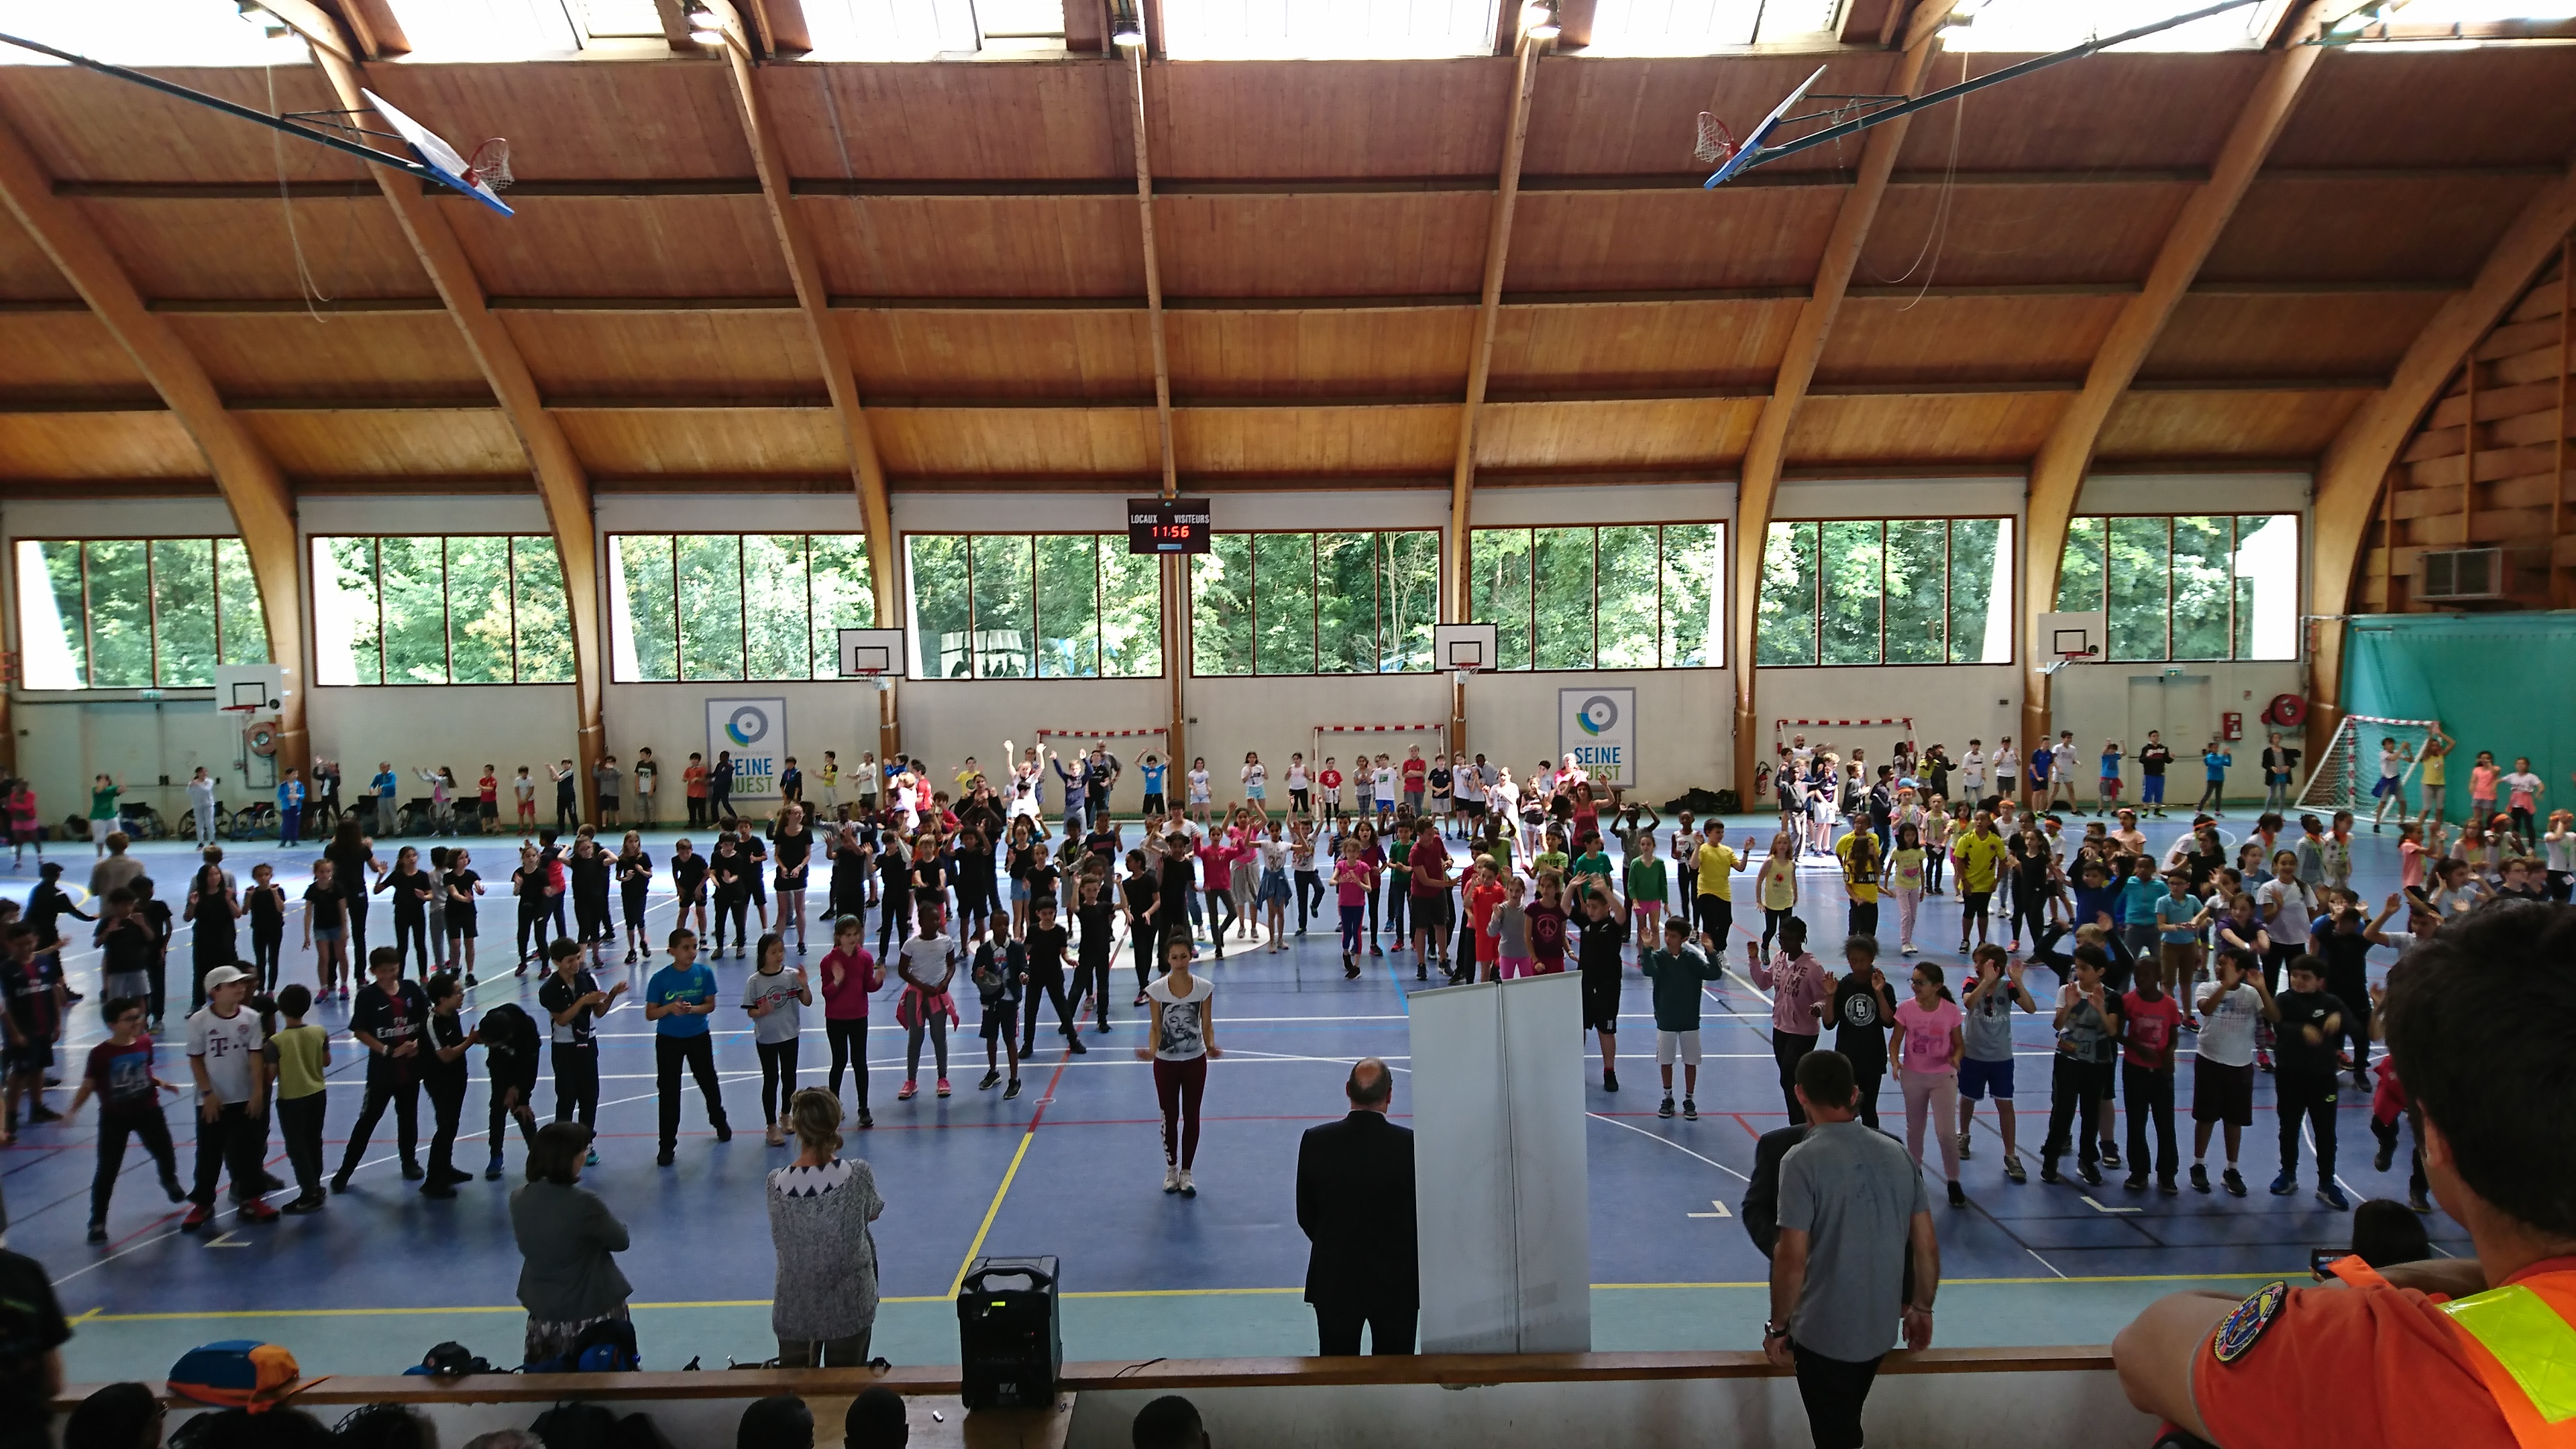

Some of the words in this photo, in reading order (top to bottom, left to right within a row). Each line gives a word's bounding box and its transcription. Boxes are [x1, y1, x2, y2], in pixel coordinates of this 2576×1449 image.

[1130, 514, 1158, 524] LOCAUX
[1174, 514, 1210, 524] VISITEURS
[1574, 747, 1621, 763] SEINE
[727, 758, 773, 775] EINE
[1578, 765, 1621, 781] UEST
